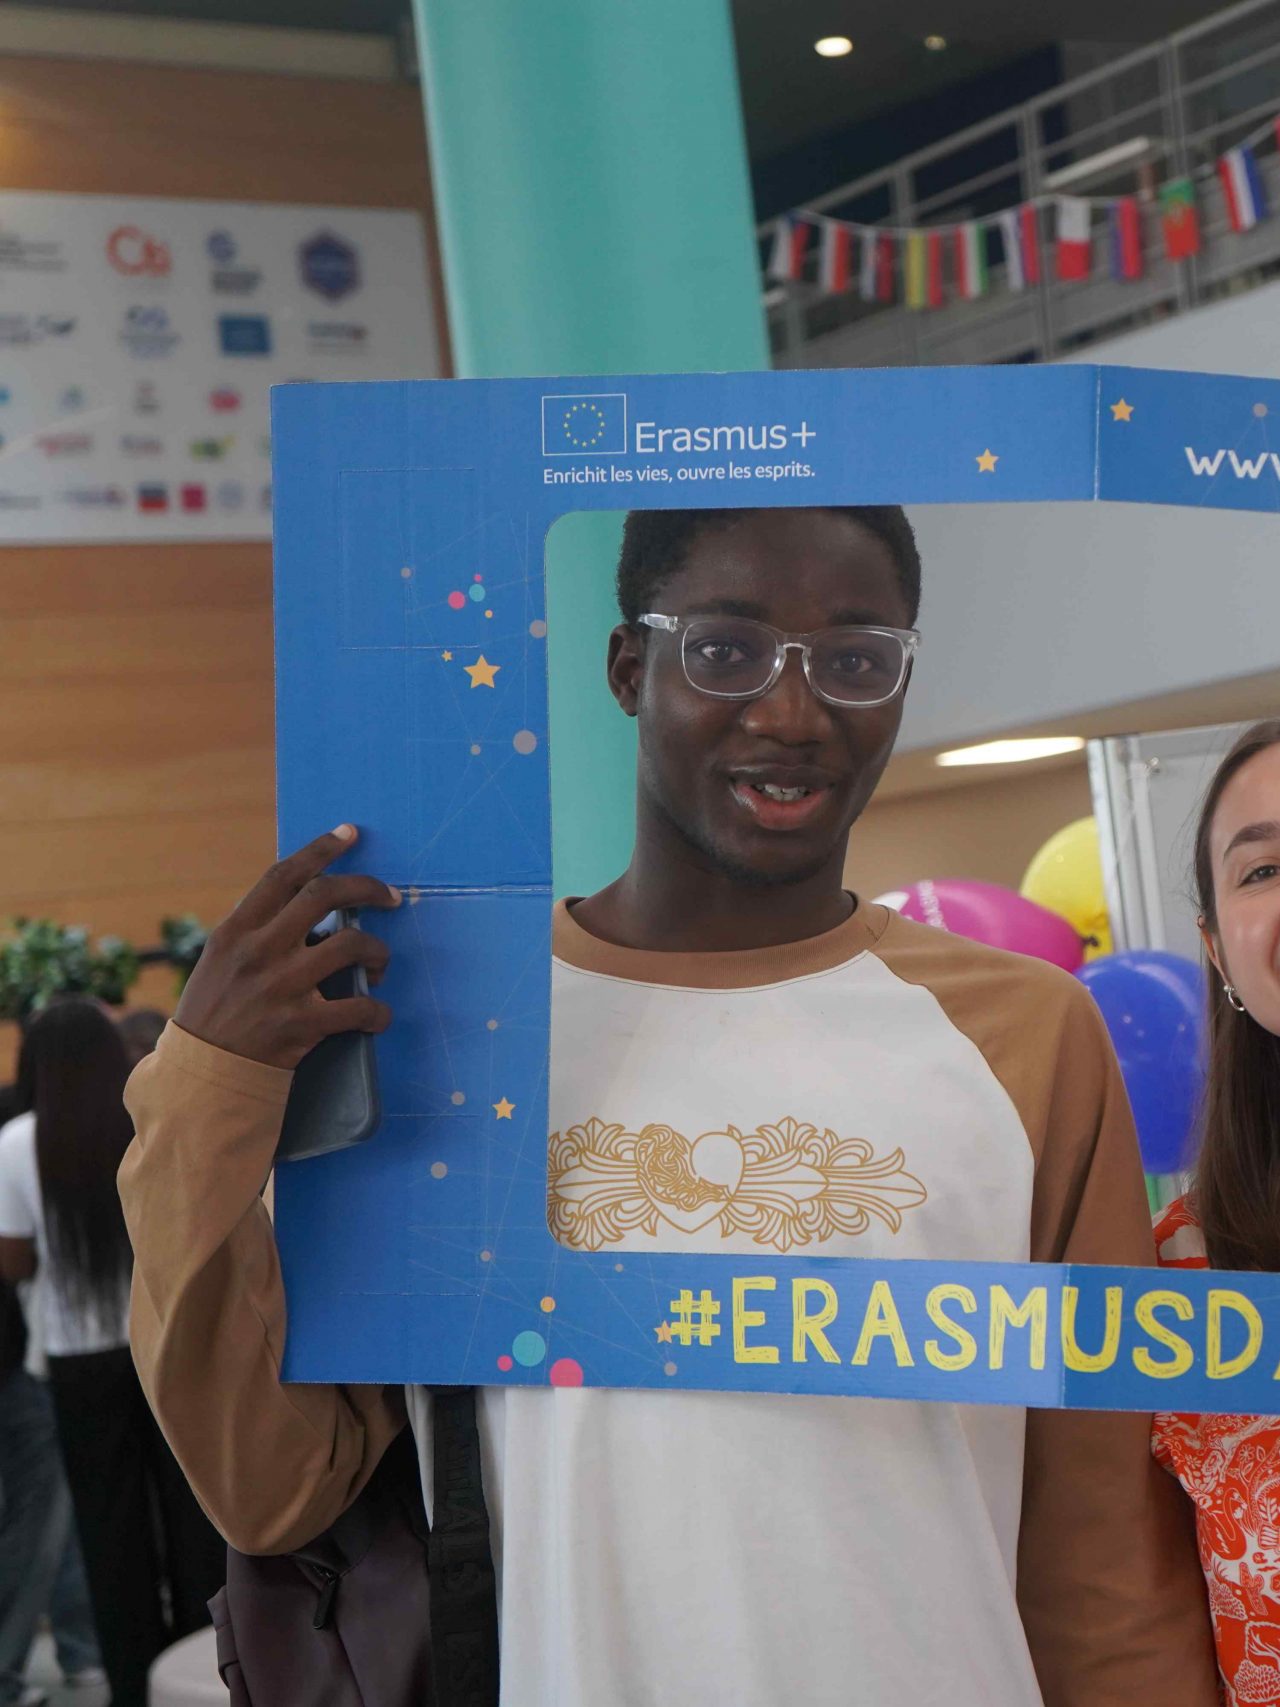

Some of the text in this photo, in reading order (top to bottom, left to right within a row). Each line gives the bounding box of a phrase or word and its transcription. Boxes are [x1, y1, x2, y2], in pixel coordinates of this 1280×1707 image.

[635, 421, 817, 454] Erasmus+
[543, 460, 817, 485] Enrichit les vies, ouvre les esprits.
